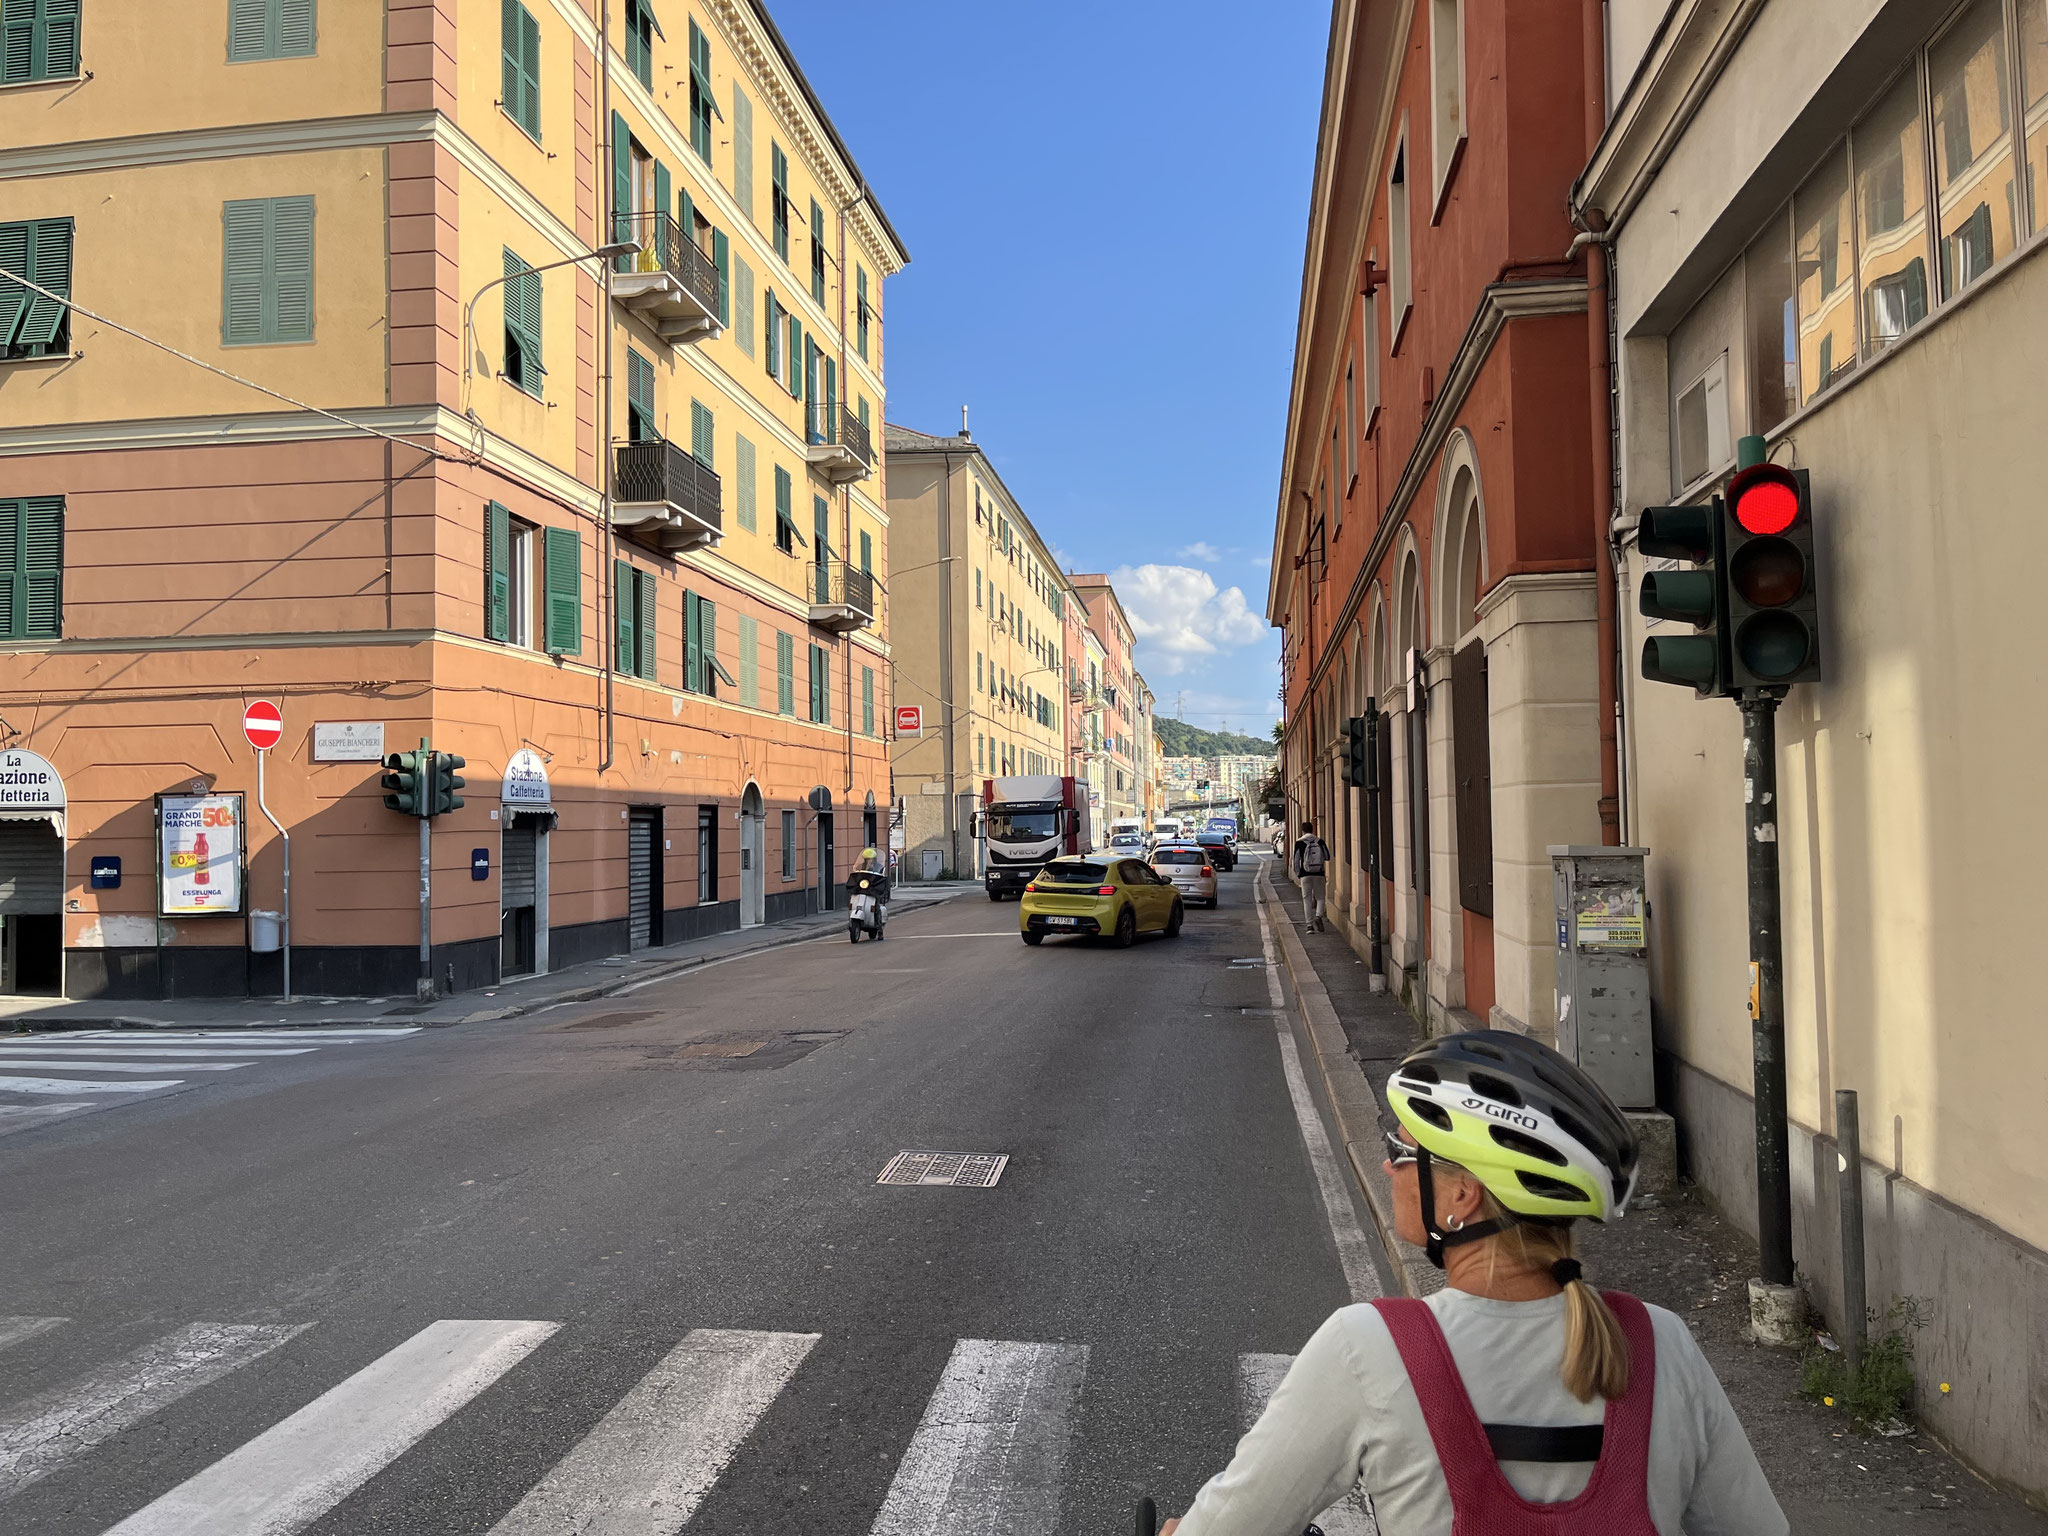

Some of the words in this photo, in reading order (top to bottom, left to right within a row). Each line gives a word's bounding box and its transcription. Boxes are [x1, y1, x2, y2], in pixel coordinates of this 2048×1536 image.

[318, 738, 346, 747] GIUSEPPE
[6, 755, 22, 767] La
[511, 766, 543, 783] Stazione
[510, 784, 544, 798] Caffetteria
[165, 812, 202, 820] GRANDI
[165, 820, 203, 828] MARCHE
[1212, 823, 1232, 831] Lyreco
[1485, 1103, 1539, 1131] GIRO
